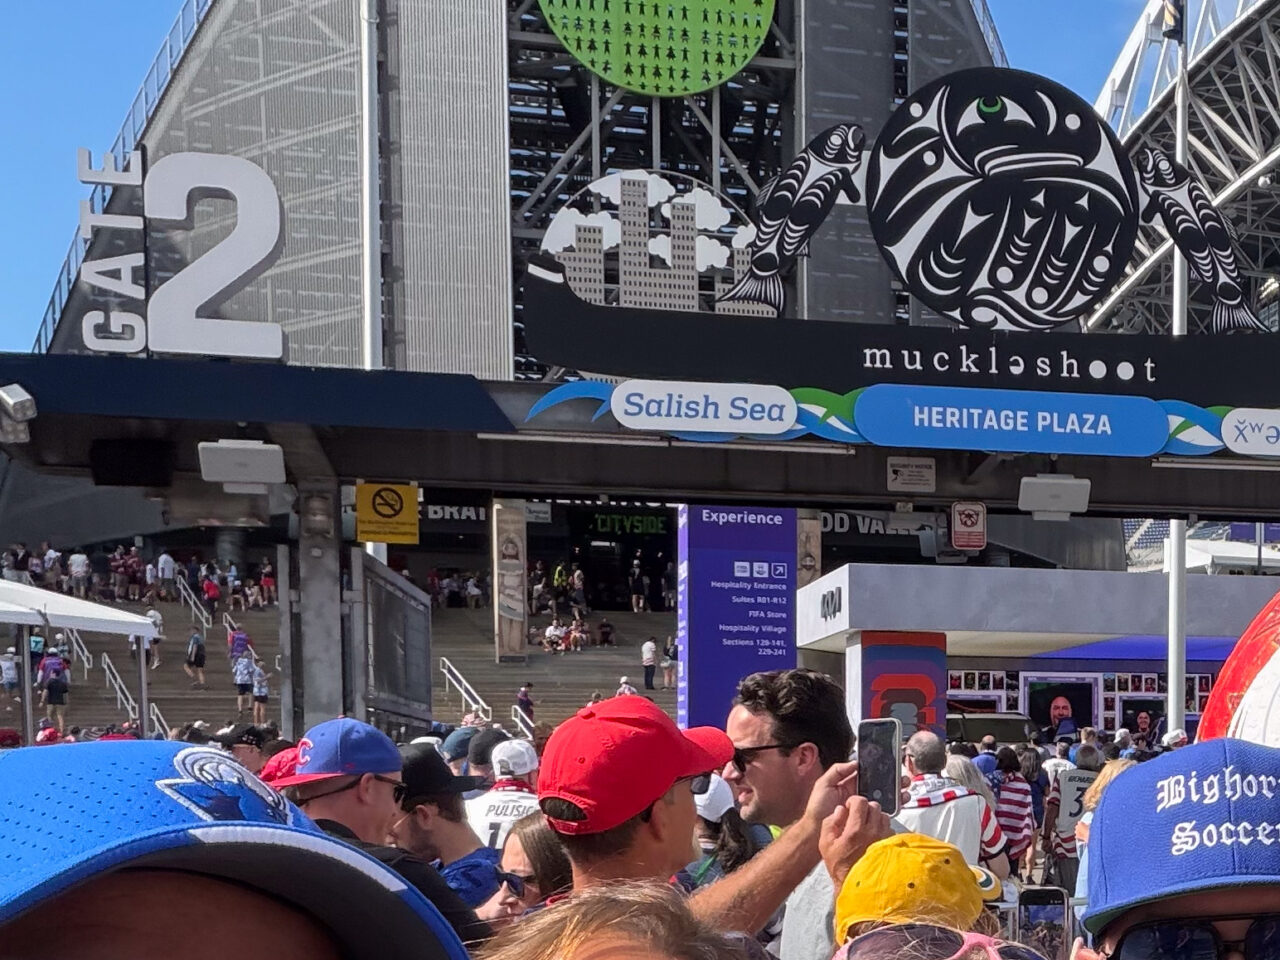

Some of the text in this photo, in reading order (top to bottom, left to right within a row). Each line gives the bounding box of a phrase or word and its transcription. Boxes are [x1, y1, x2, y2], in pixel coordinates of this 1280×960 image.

[78, 147, 146, 354] GATE
[144, 152, 282, 358] 2
[623, 391, 787, 423] Salish Sea
[912, 405, 1113, 436] HERITAGE PLAZA
[596, 514, 668, 534] CITYSIDE
[702, 509, 784, 525] Experience
[711, 581, 787, 591] Hospitality Entrance
[748, 610, 765, 619] FIFA
[718, 624, 760, 634] Hospitality
